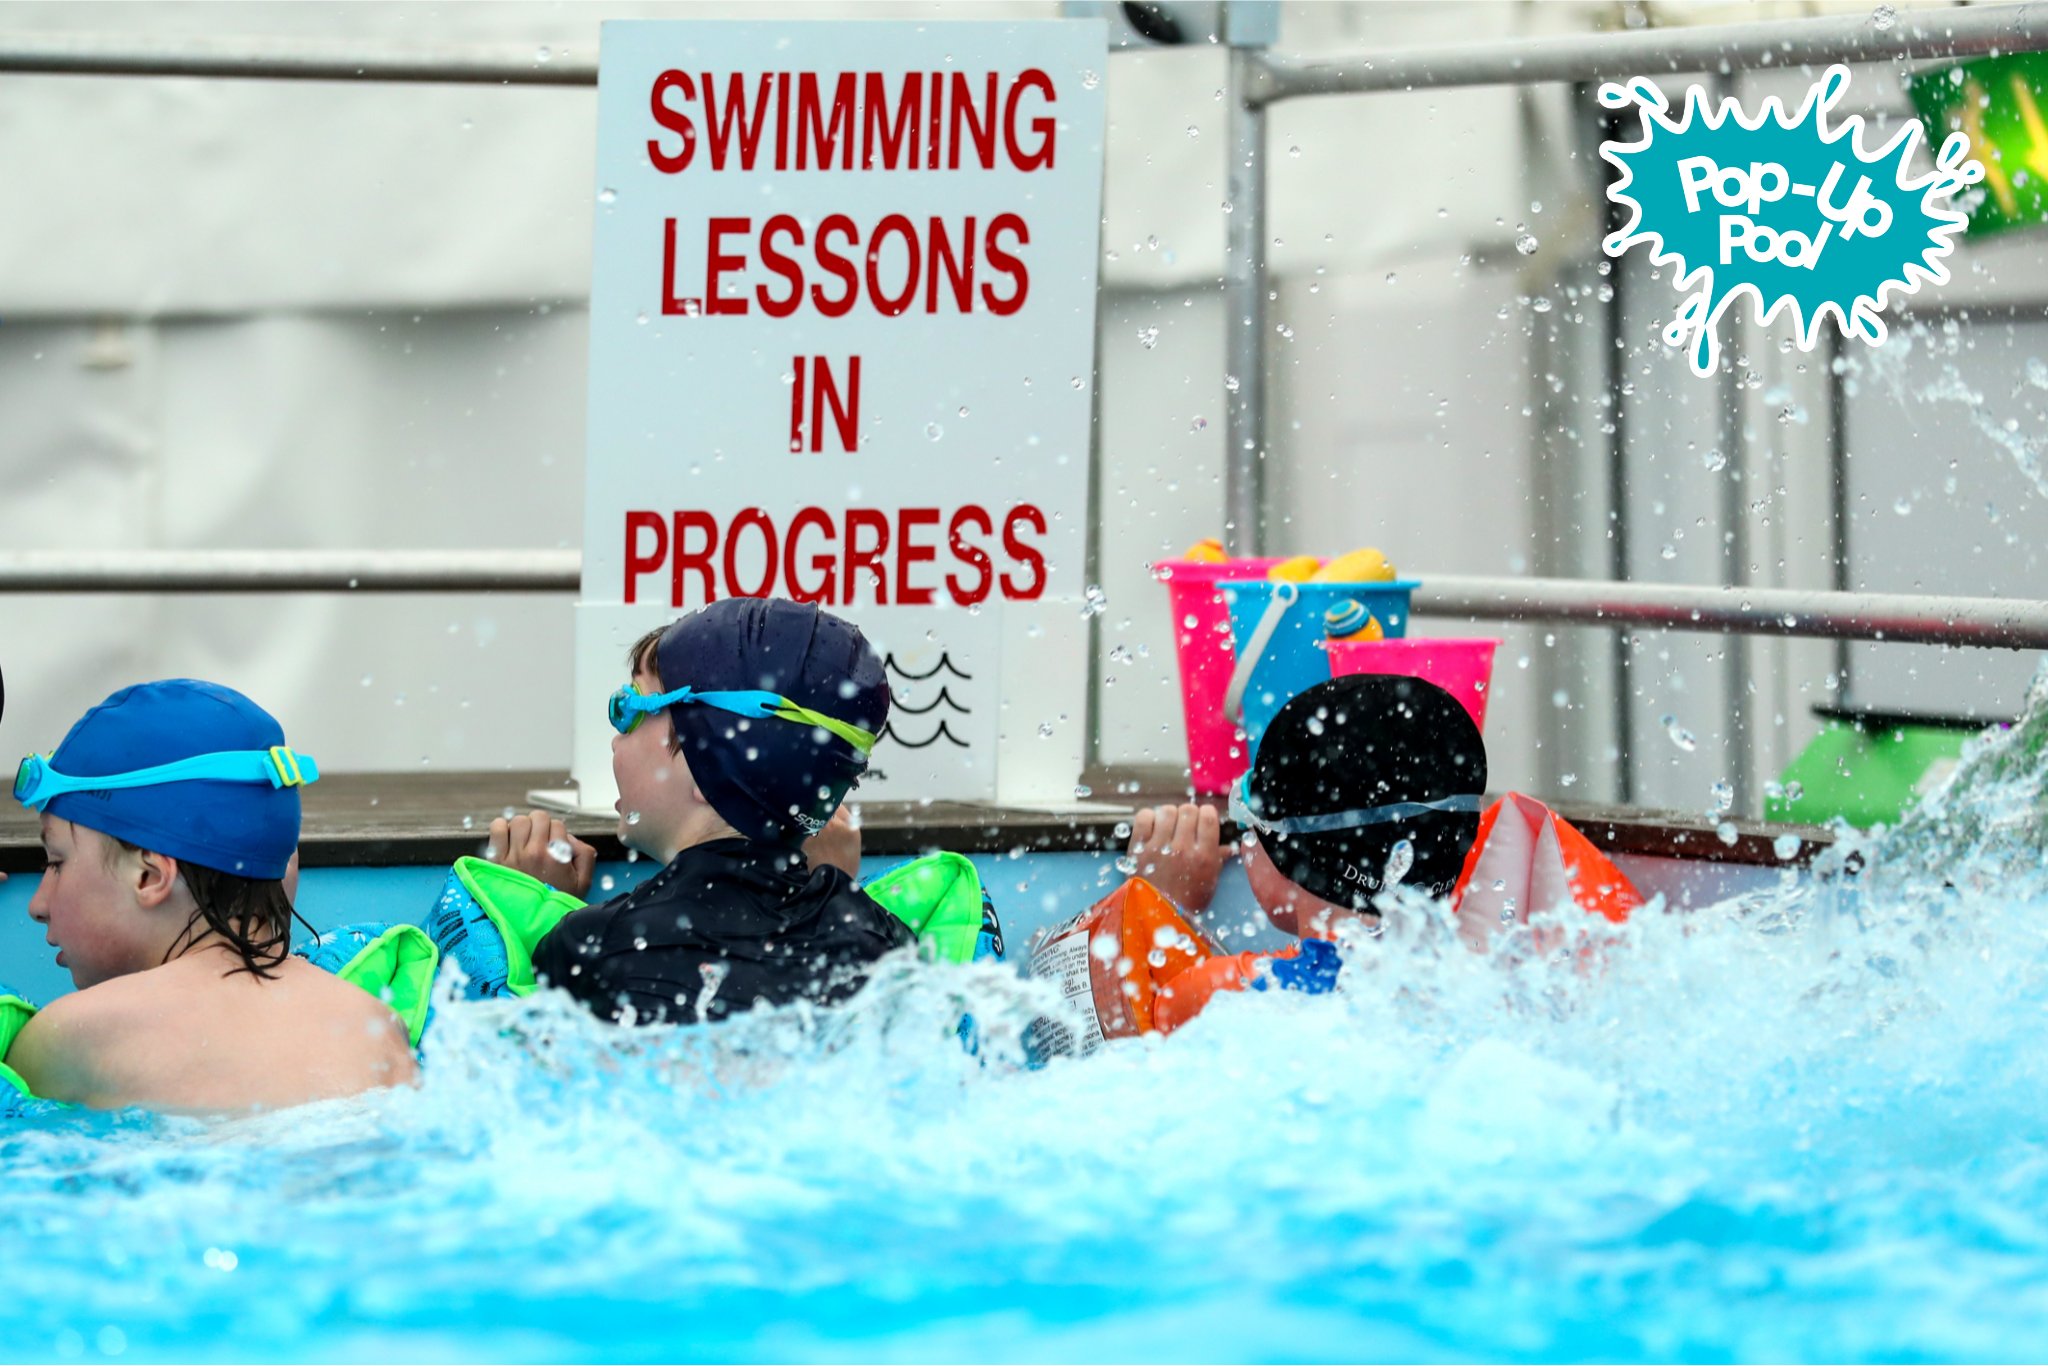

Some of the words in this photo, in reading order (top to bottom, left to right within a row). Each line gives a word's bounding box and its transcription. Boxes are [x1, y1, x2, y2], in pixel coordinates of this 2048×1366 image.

[647, 69, 1057, 174] SWIMMING
[661, 213, 1030, 317] LESSONS
[790, 355, 861, 453] IN
[623, 504, 1048, 608] PROGRESS
